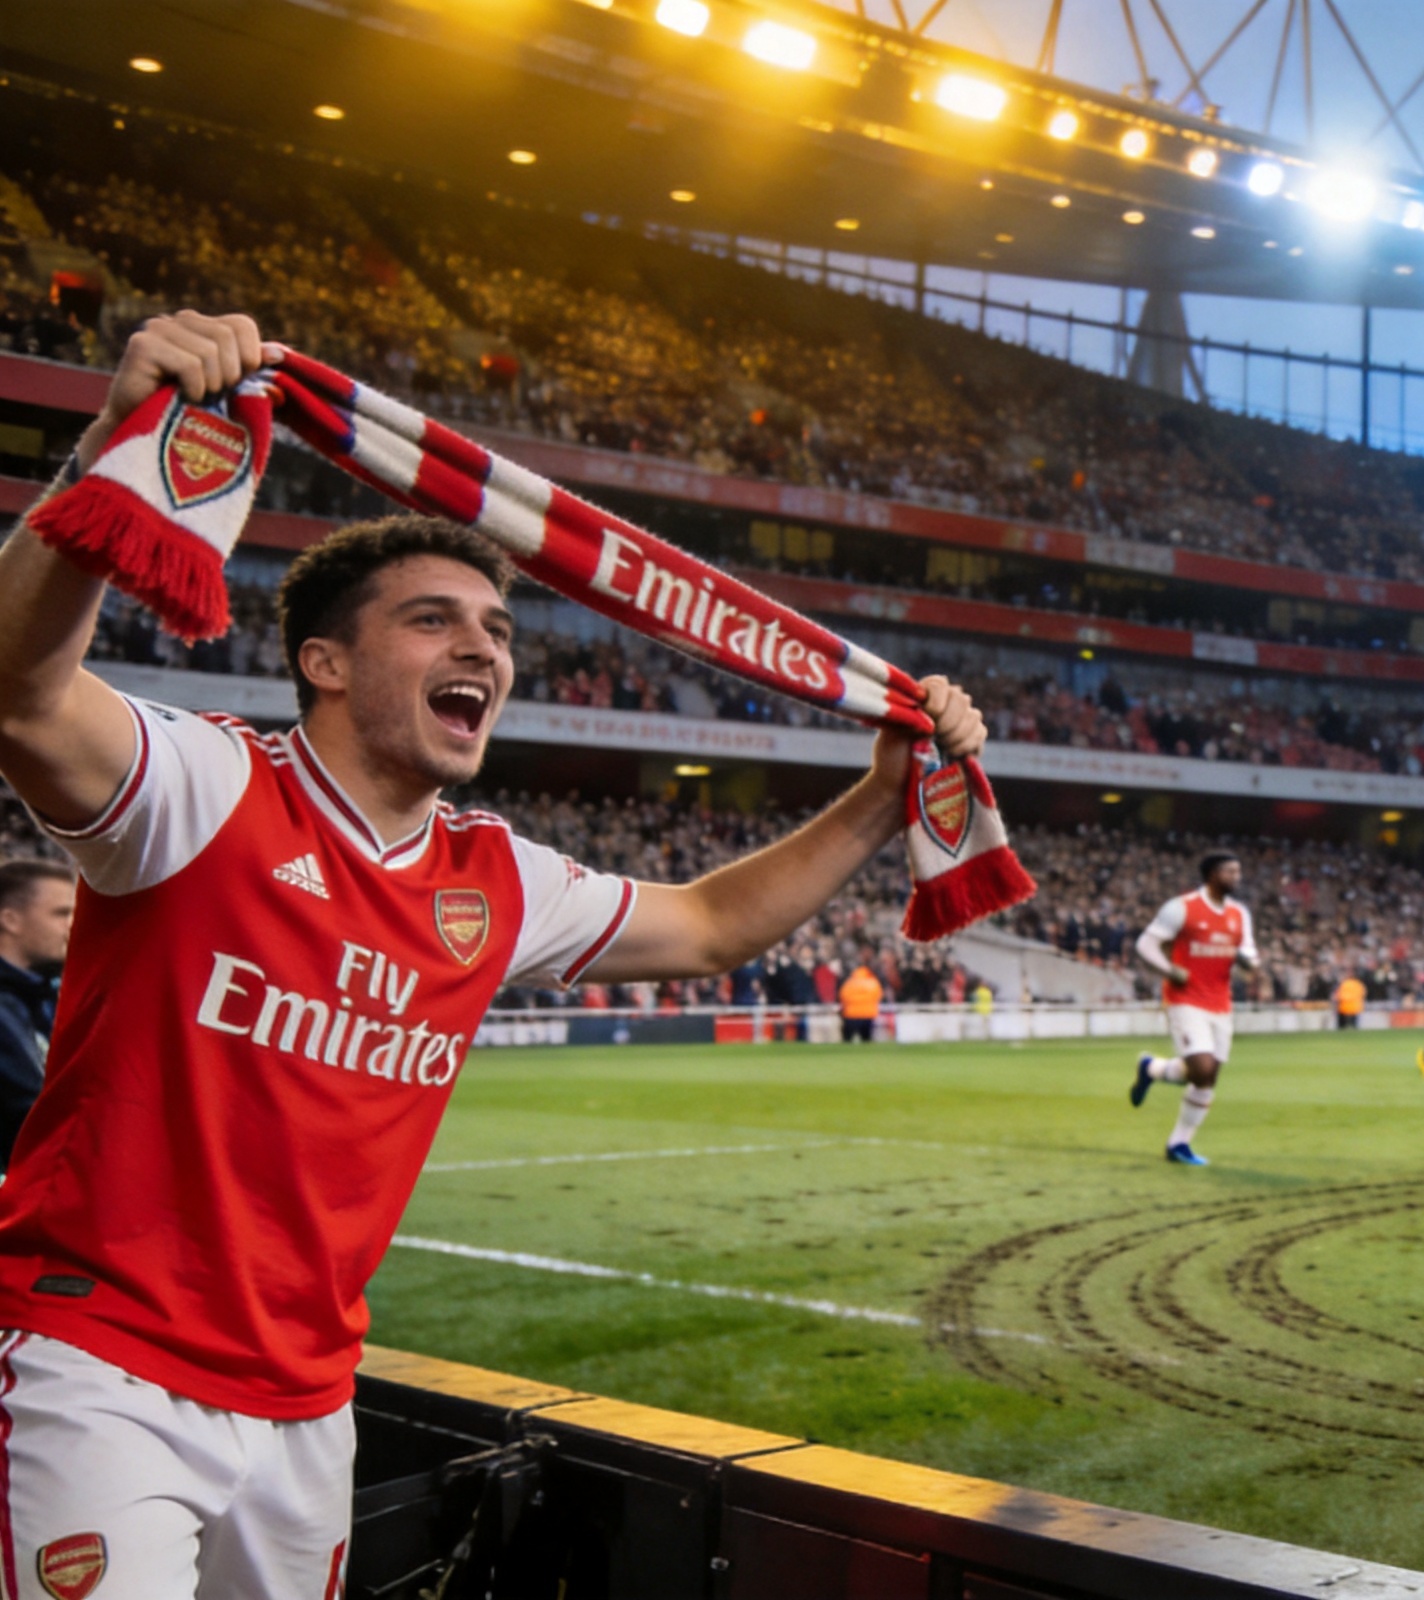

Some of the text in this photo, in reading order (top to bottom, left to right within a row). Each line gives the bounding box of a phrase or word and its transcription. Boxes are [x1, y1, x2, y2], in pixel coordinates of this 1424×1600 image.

[589, 527, 828, 690] Emirates
[197, 951, 464, 1087] Emirates
[336, 940, 419, 1016] Fly
